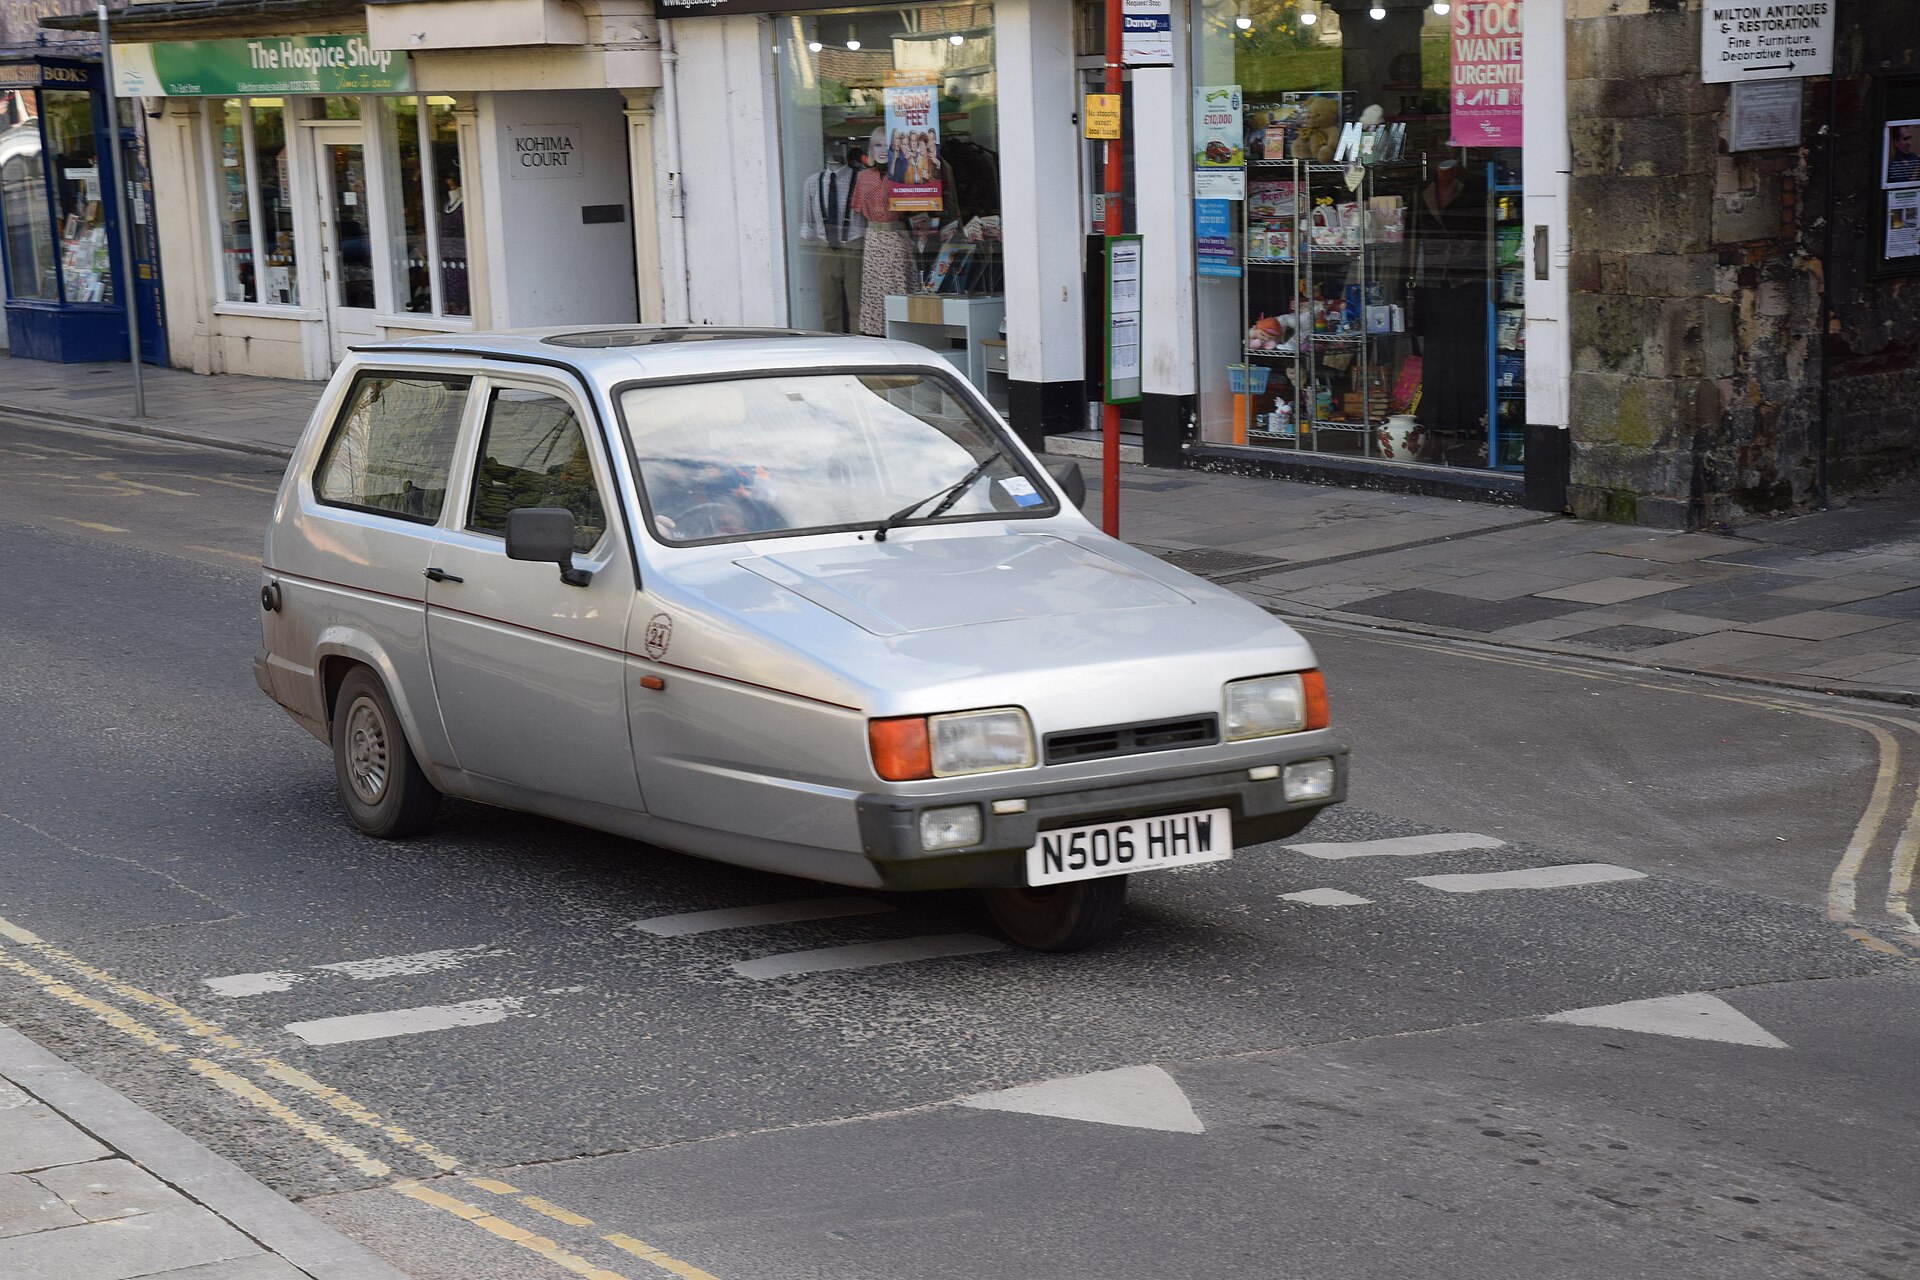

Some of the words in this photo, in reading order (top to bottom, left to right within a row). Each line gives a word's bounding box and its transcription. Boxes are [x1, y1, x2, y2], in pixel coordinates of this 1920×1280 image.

[1456, 3, 1524, 35] STOC
[1714, 8, 1761, 20] MILTON
[1766, 3, 1828, 17] ANTIQUES
[1721, 23, 1731, 33] &
[1455, 38, 1523, 61] WANTE
[1728, 37, 1751, 48] Fine
[247, 41, 278, 68] The
[280, 39, 345, 74] Hospice
[347, 37, 392, 73] Shop
[1722, 49, 1781, 61] Decorative
[43, 67, 88, 82] BOOKS
[1454, 64, 1523, 84] URGENTL
[906, 109, 930, 126] FEET
[1205, 114, 1233, 126] £10,000
[515, 137, 574, 151] KOHIMA
[522, 152, 569, 167] COURT
[1041, 825, 1134, 875] N506
[1147, 814, 1212, 859] HHW
